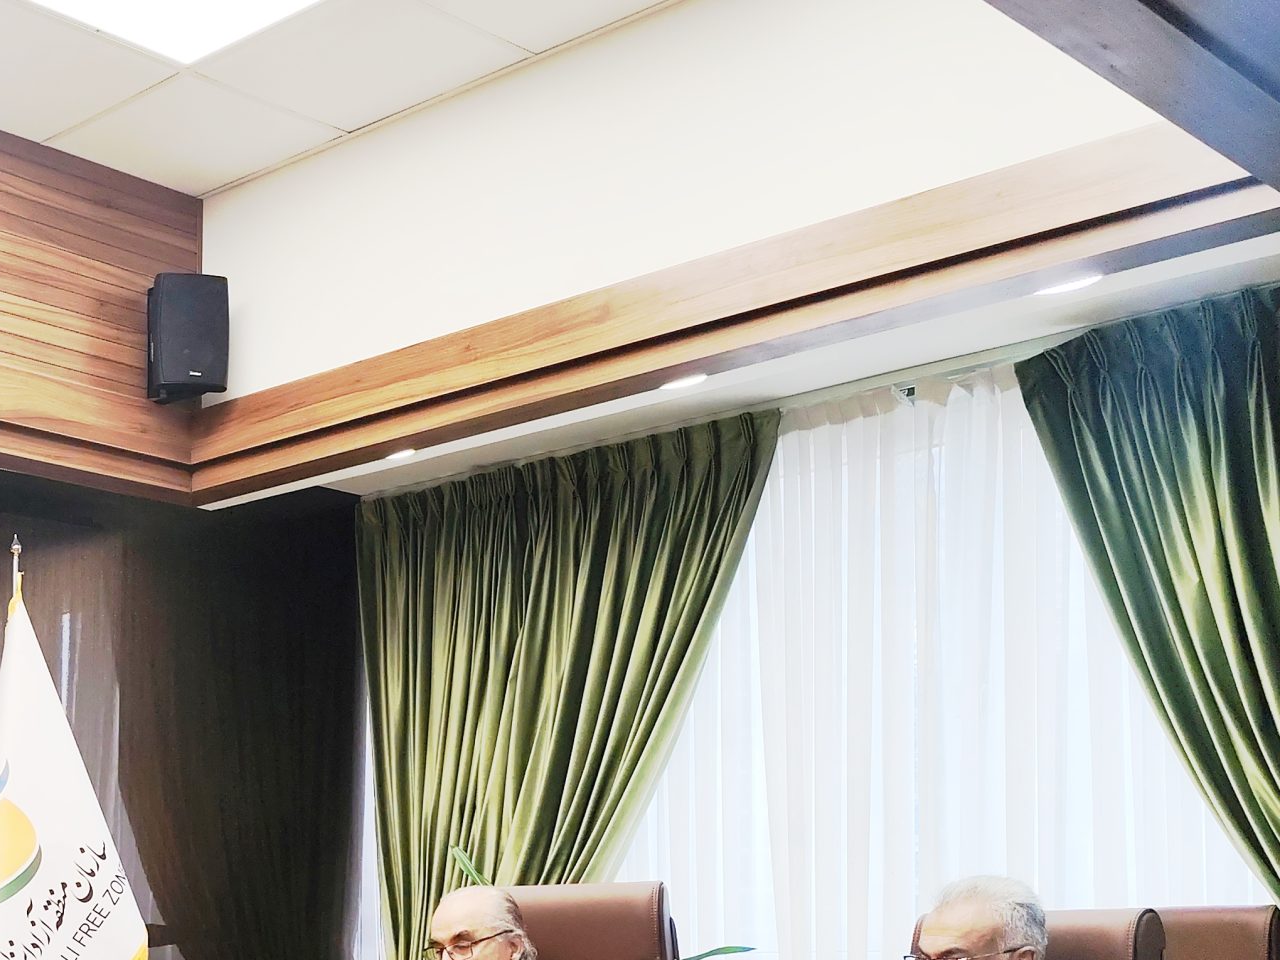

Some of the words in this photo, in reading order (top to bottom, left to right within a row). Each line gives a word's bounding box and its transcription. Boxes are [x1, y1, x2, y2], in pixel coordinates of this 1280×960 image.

[71, 841, 107, 903] سازمان
[25, 898, 54, 956] آزاد
[43, 881, 68, 931] منطقه
[72, 903, 111, 947] FREE
